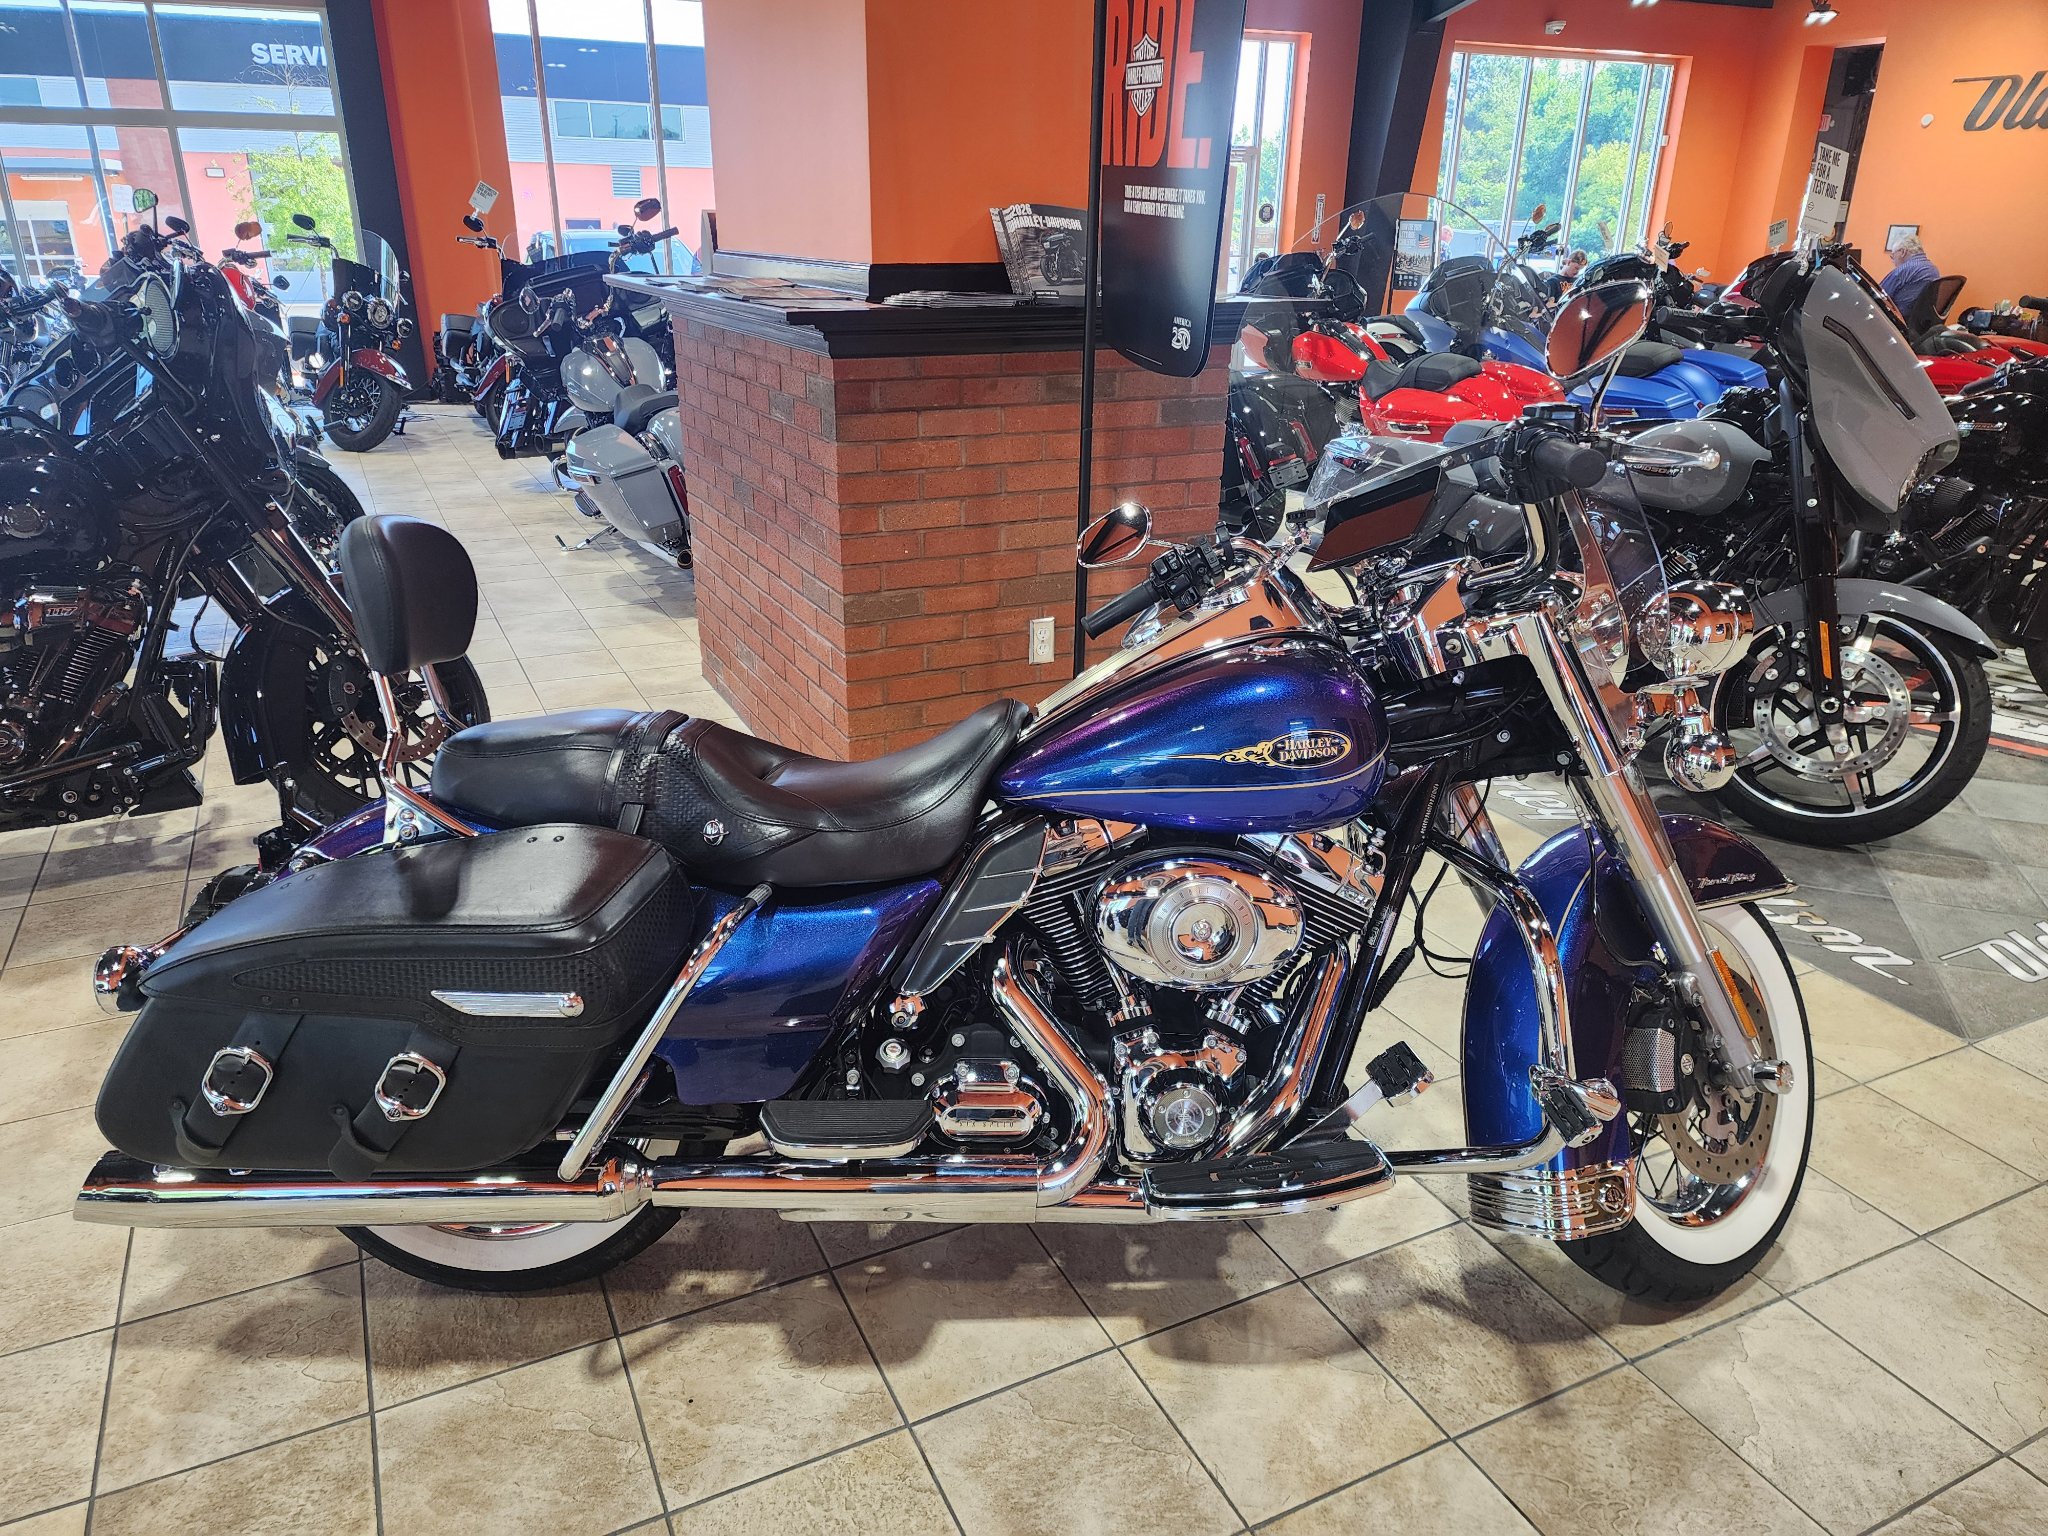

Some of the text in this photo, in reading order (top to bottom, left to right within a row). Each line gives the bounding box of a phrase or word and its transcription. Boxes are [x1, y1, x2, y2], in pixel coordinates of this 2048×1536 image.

[1135, 40, 1156, 62] MOTOR
[1133, 88, 1154, 112] CYCLES
[1820, 145, 1842, 167] TAKE ME
[1816, 162, 1826, 179] FOR
[1812, 178, 1839, 200] TEST RIDE
[1010, 203, 1033, 216] 2026
[1014, 215, 1083, 231] HARLEY-DAVIDSON
[46, 606, 78, 617] 117
[1279, 747, 1338, 762] DAVIDSON
